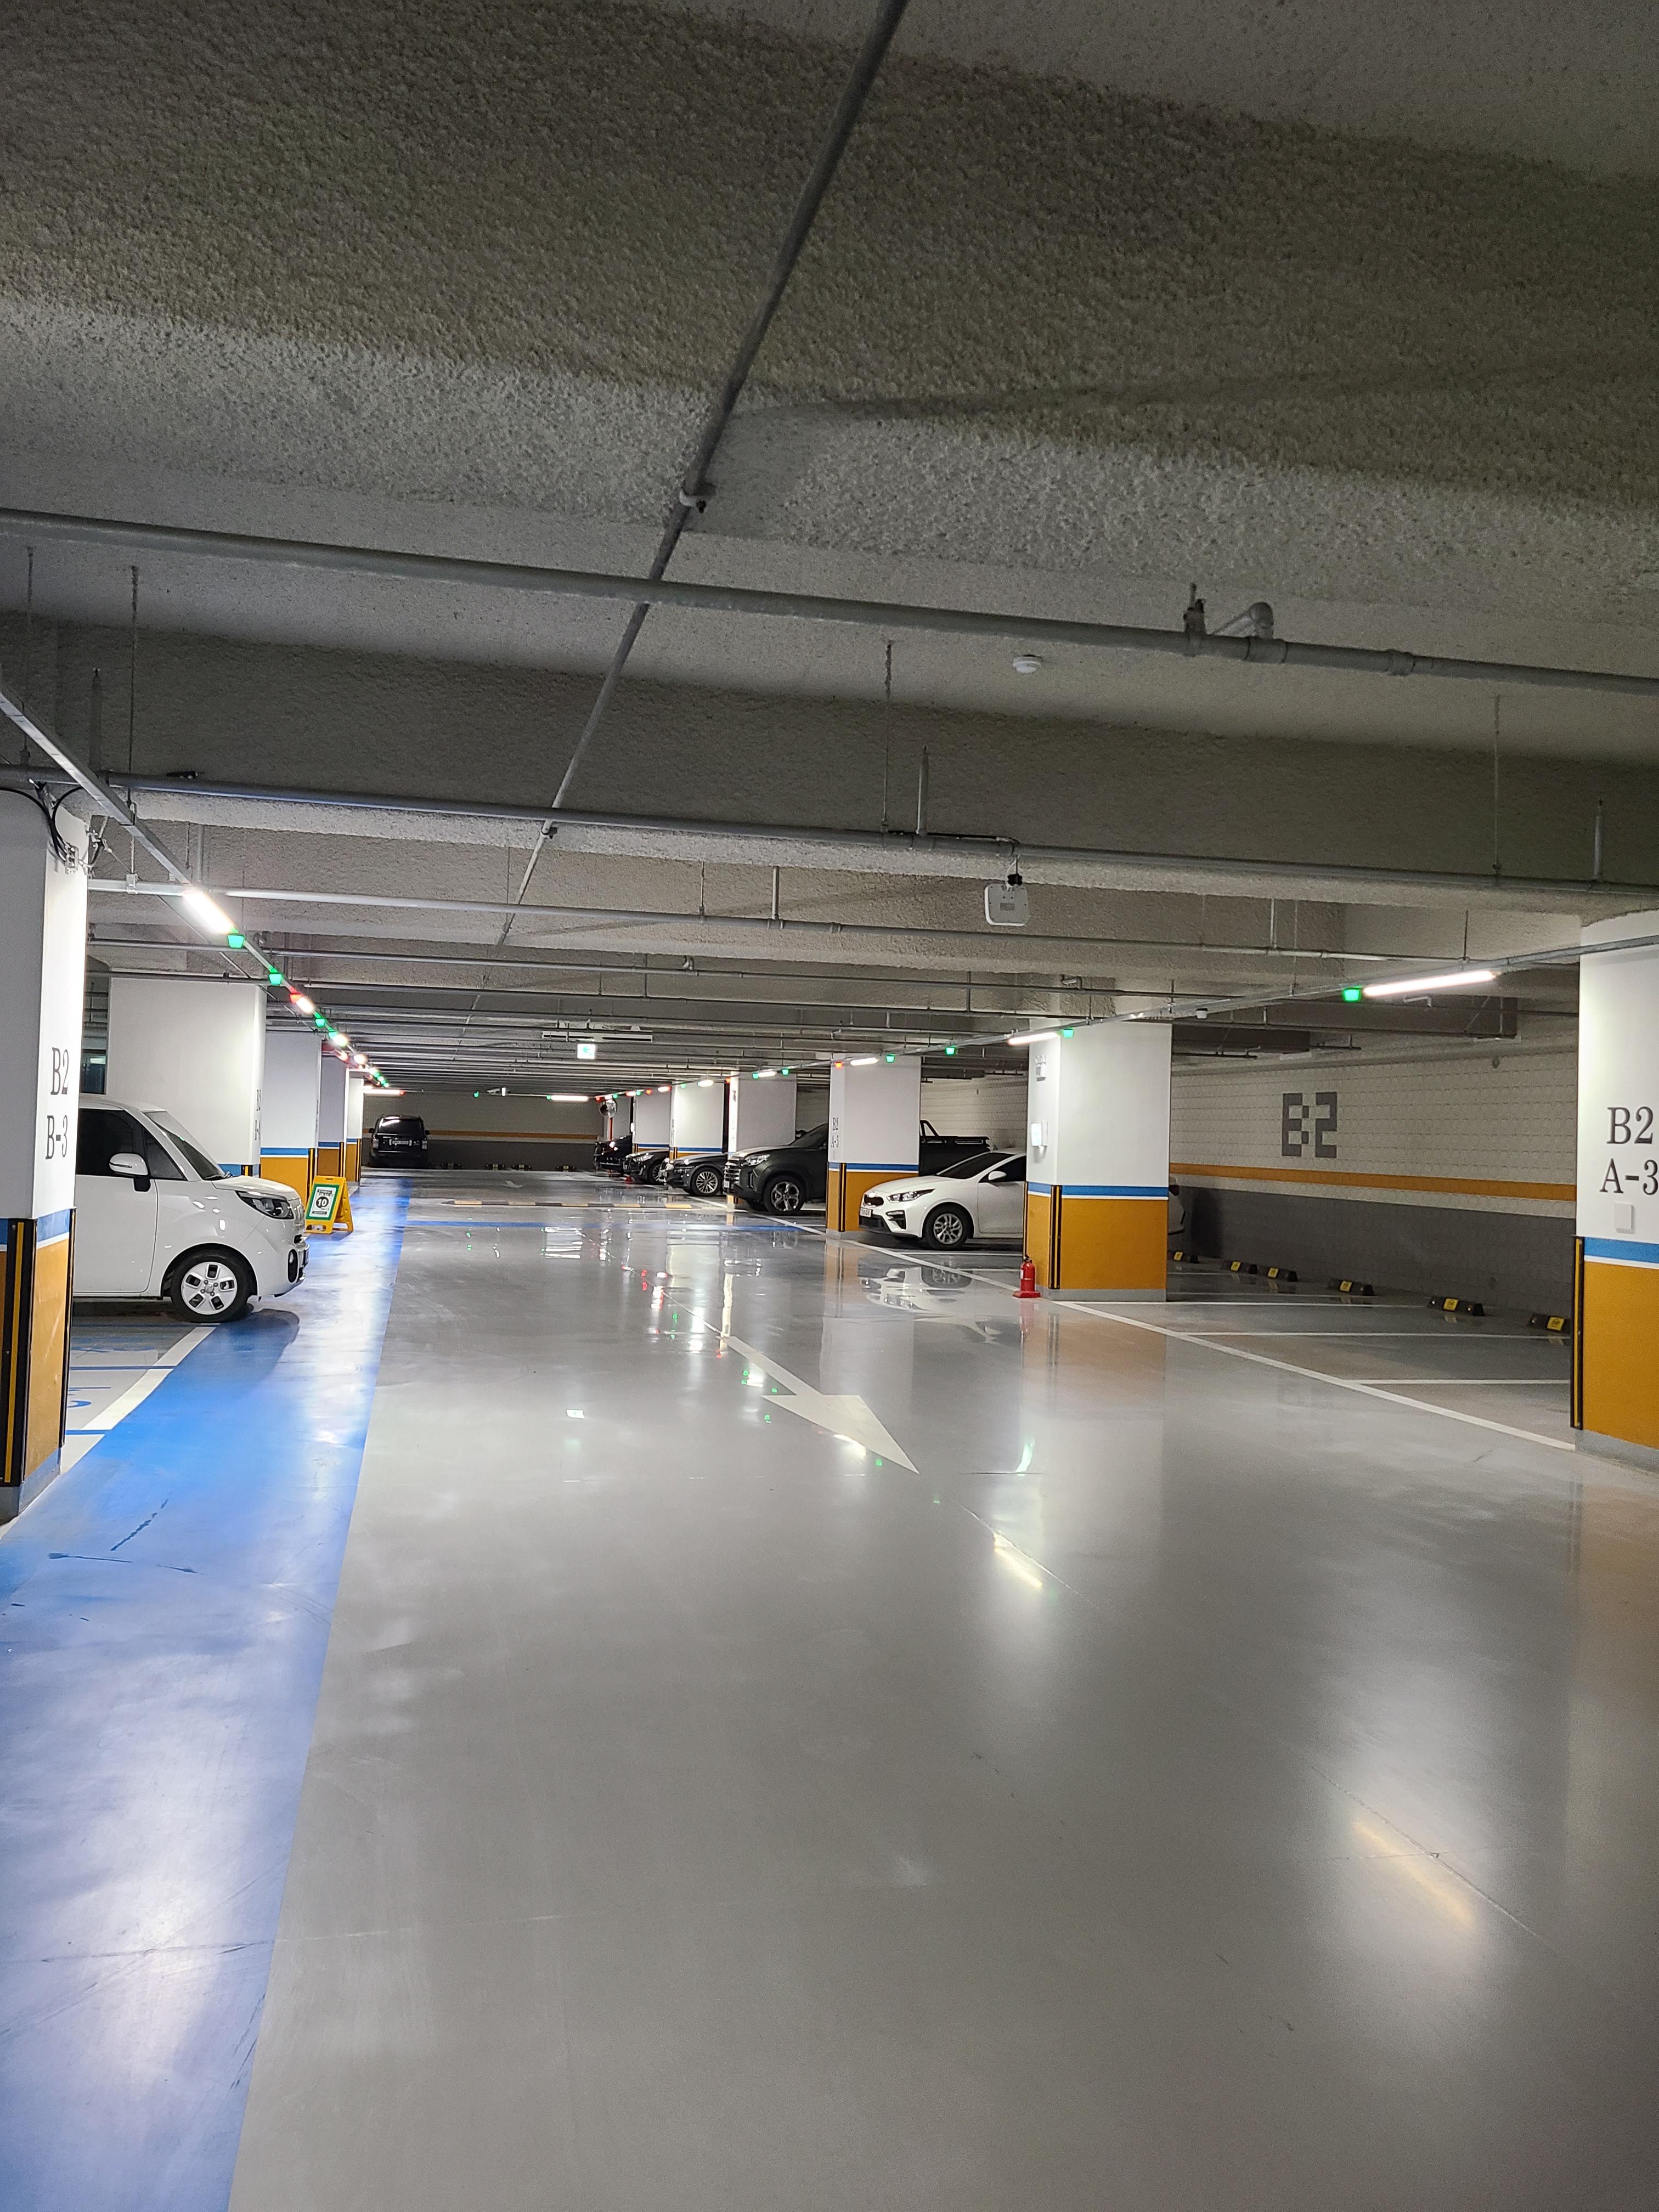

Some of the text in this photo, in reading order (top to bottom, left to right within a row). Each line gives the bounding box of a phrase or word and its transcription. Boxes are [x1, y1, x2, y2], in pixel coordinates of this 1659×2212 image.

[50, 1047, 69, 1096] B2
[46, 1114, 68, 1160] B-3
[832, 1117, 839, 1131] B2
[1282, 1091, 1338, 1159] B2
[1606, 1106, 1653, 1144] B2
[1599, 1158, 1658, 1195] A-3
[318, 1198, 328, 1206] 10
